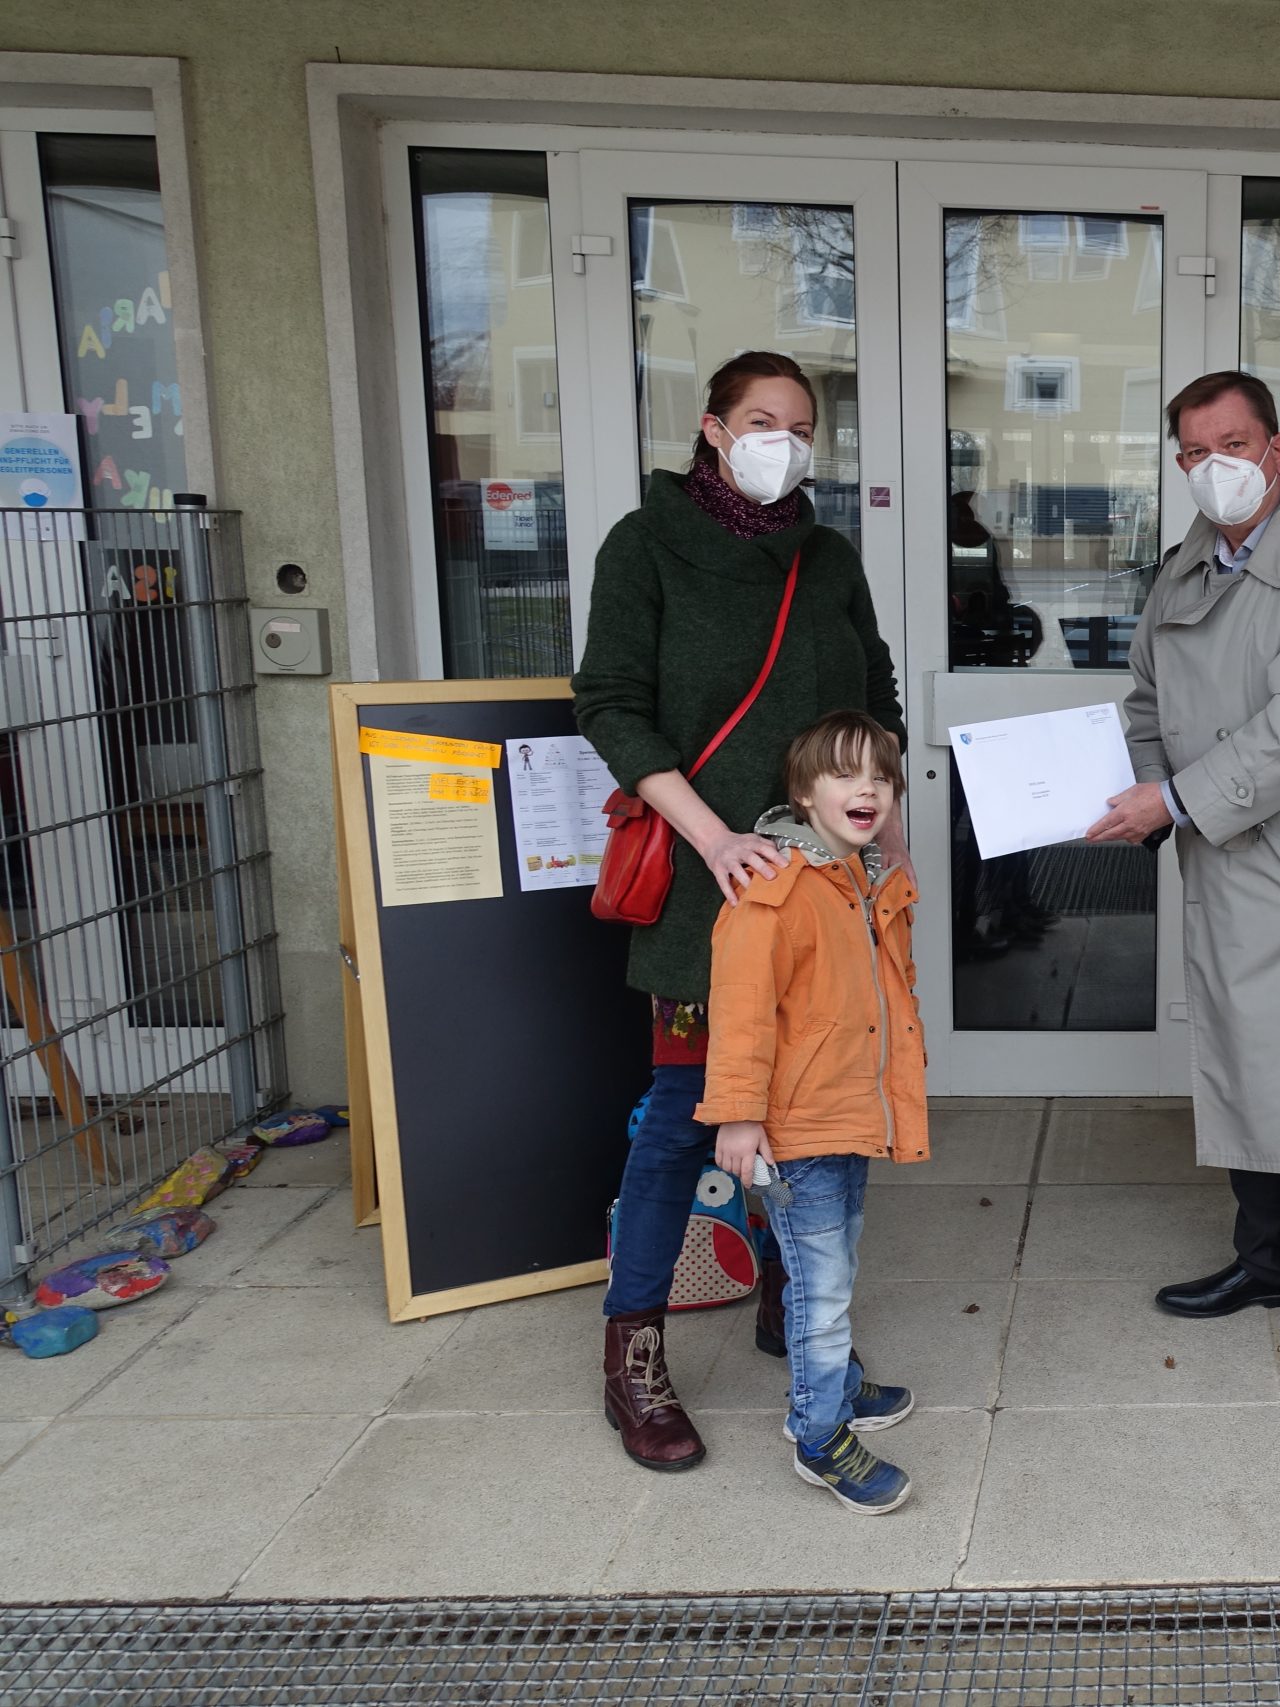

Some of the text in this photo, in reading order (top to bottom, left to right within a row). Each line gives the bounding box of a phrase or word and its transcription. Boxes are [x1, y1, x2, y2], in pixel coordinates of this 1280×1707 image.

[55, 456, 69, 464] FÜR
[0, 466, 73, 474] EGLEITPERSONEN
[487, 490, 532, 500] Edenred
